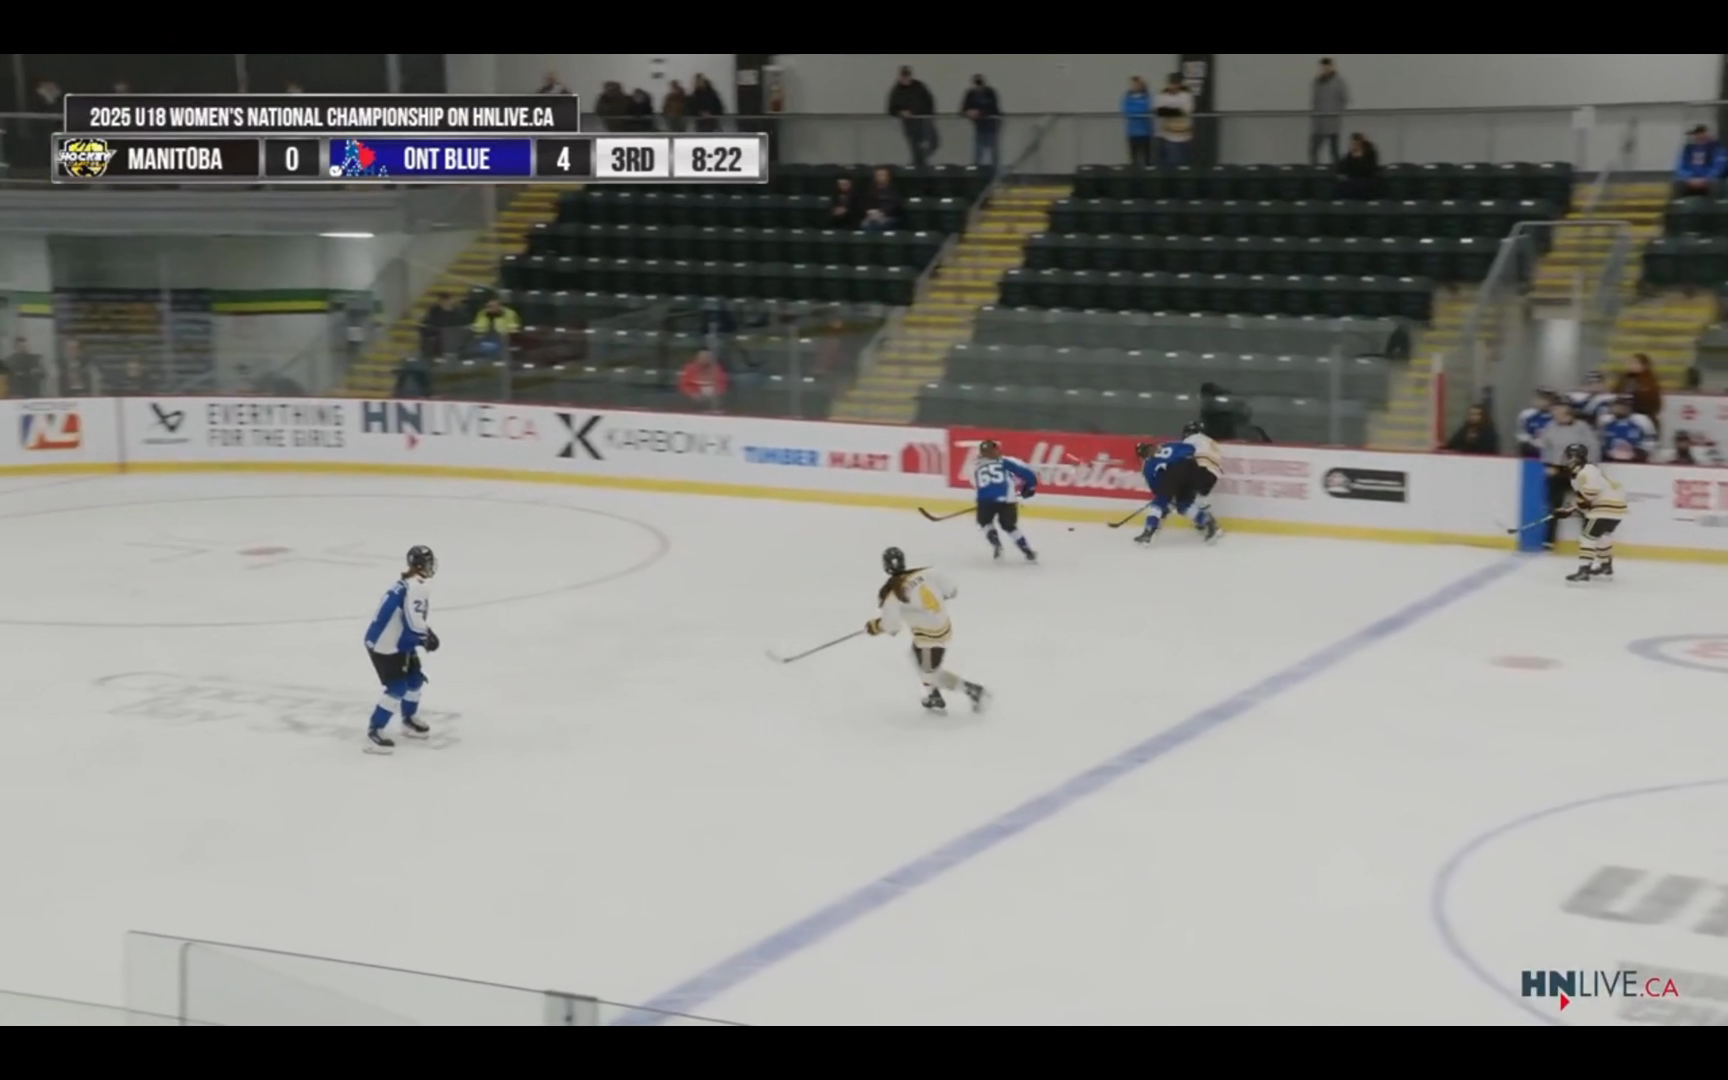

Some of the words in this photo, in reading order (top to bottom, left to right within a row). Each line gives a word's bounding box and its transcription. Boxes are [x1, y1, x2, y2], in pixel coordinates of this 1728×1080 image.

[206, 403, 345, 426] EVERYTHING
[206, 428, 244, 447] FOR
[248, 429, 287, 448] THE
[292, 430, 345, 449] GIRLS
[828, 449, 891, 472] MART
[977, 463, 1004, 489] 65
